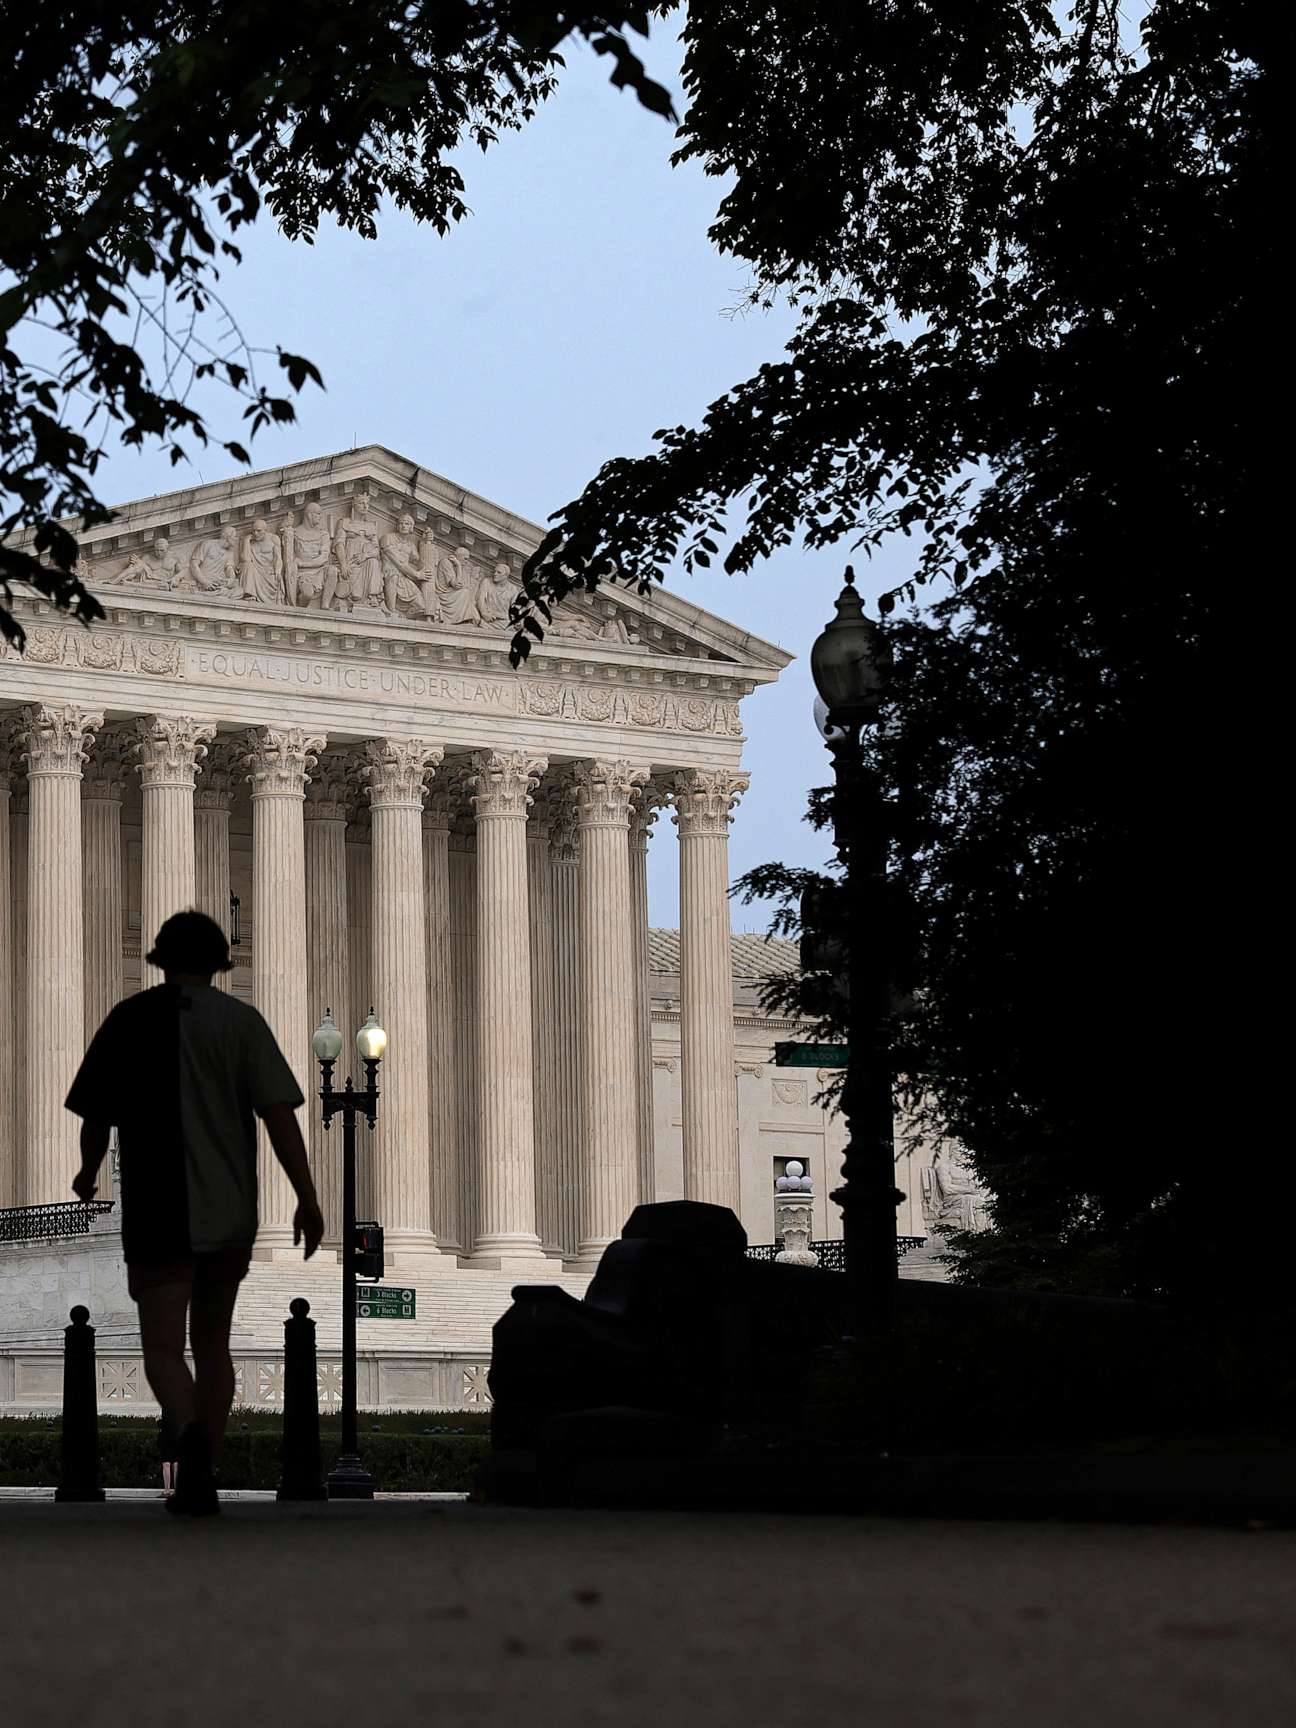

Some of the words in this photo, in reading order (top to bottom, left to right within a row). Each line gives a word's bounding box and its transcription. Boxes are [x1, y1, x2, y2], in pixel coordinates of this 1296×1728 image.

[198, 652, 276, 680] EQUAL
[281, 662, 370, 691] JUSTICE
[380, 671, 454, 699] UNDER
[461, 681, 504, 705] LAW
